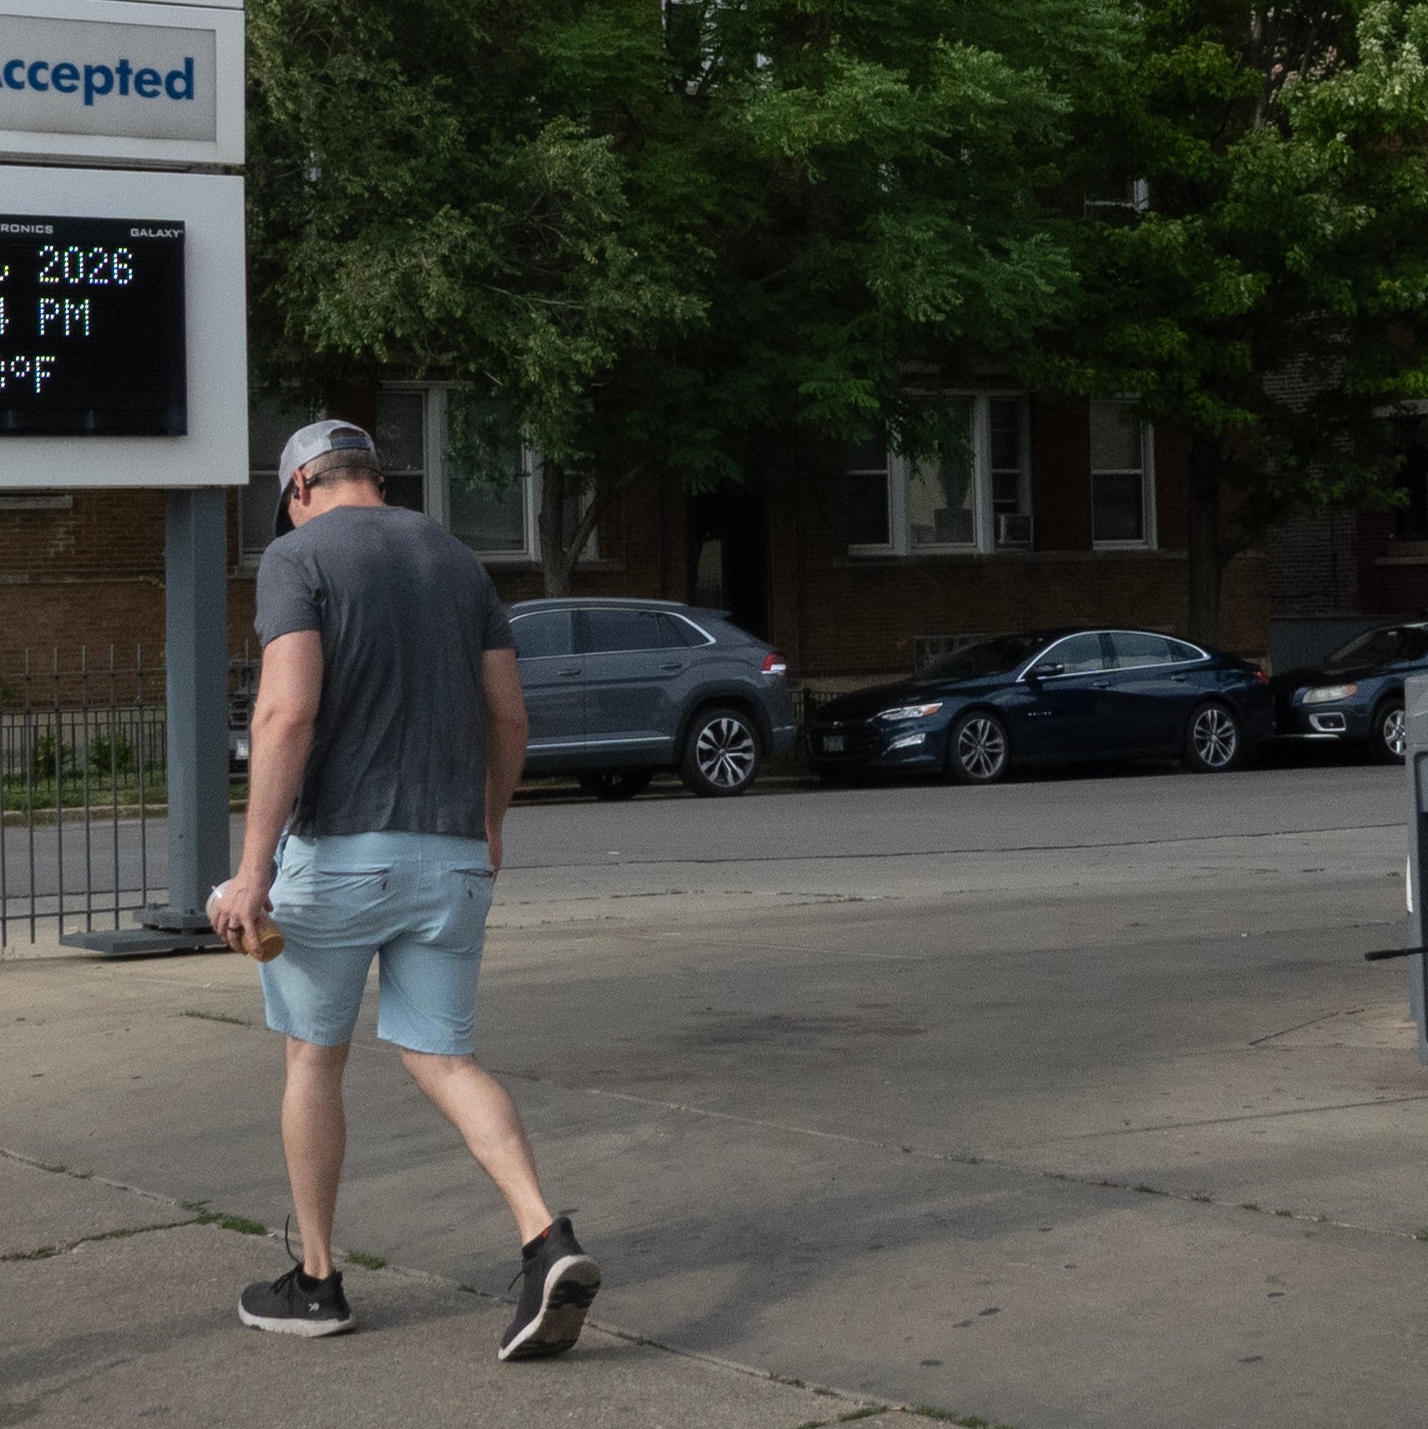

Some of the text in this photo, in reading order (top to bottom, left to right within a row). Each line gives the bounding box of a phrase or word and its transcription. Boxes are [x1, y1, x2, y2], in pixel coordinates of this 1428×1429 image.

[129, 227, 183, 239] GALAXY
[37, 244, 136, 286] 2026
[38, 296, 91, 338] PM
